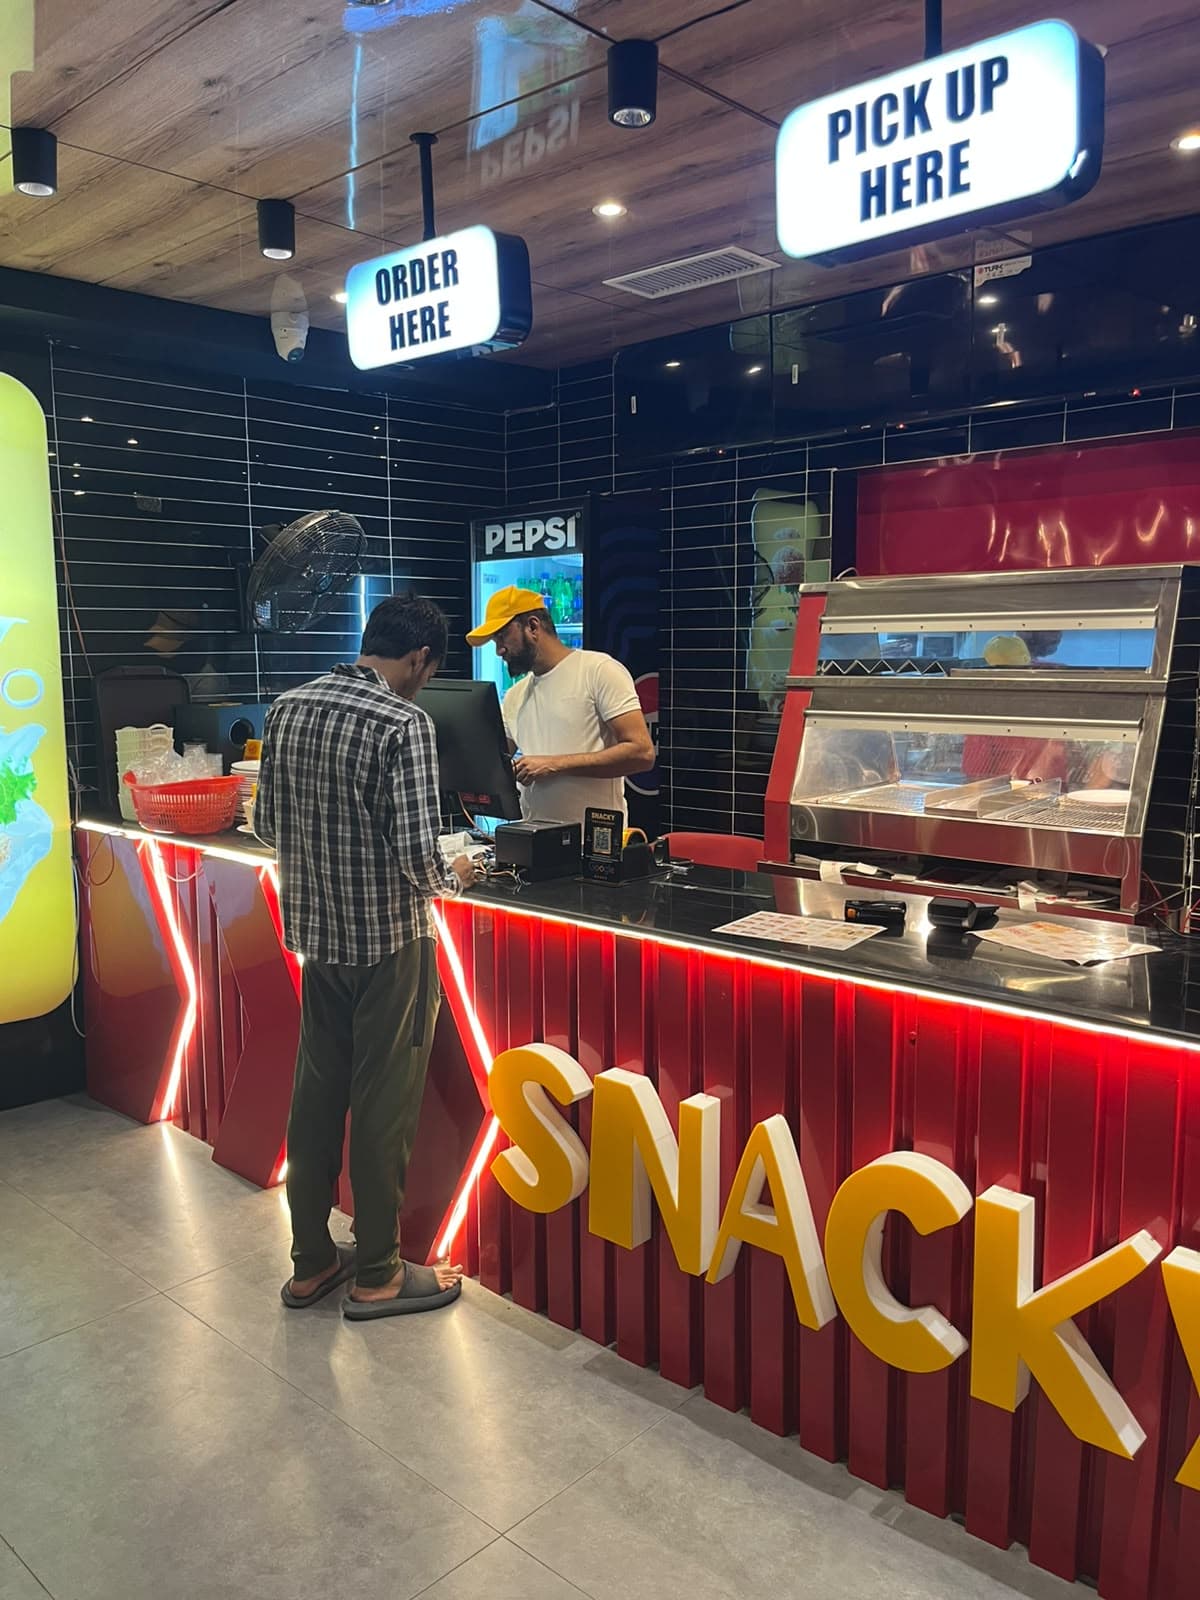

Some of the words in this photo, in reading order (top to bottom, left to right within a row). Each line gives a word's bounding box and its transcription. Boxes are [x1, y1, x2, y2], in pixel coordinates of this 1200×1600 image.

[827, 78, 933, 165] PICK
[945, 55, 1009, 124] UP
[859, 139, 971, 223] HERE
[375, 249, 460, 306] ORDER
[389, 301, 452, 352] HERE
[485, 516, 576, 555] PEPSI
[487, 1042, 1200, 1490] SNACK
